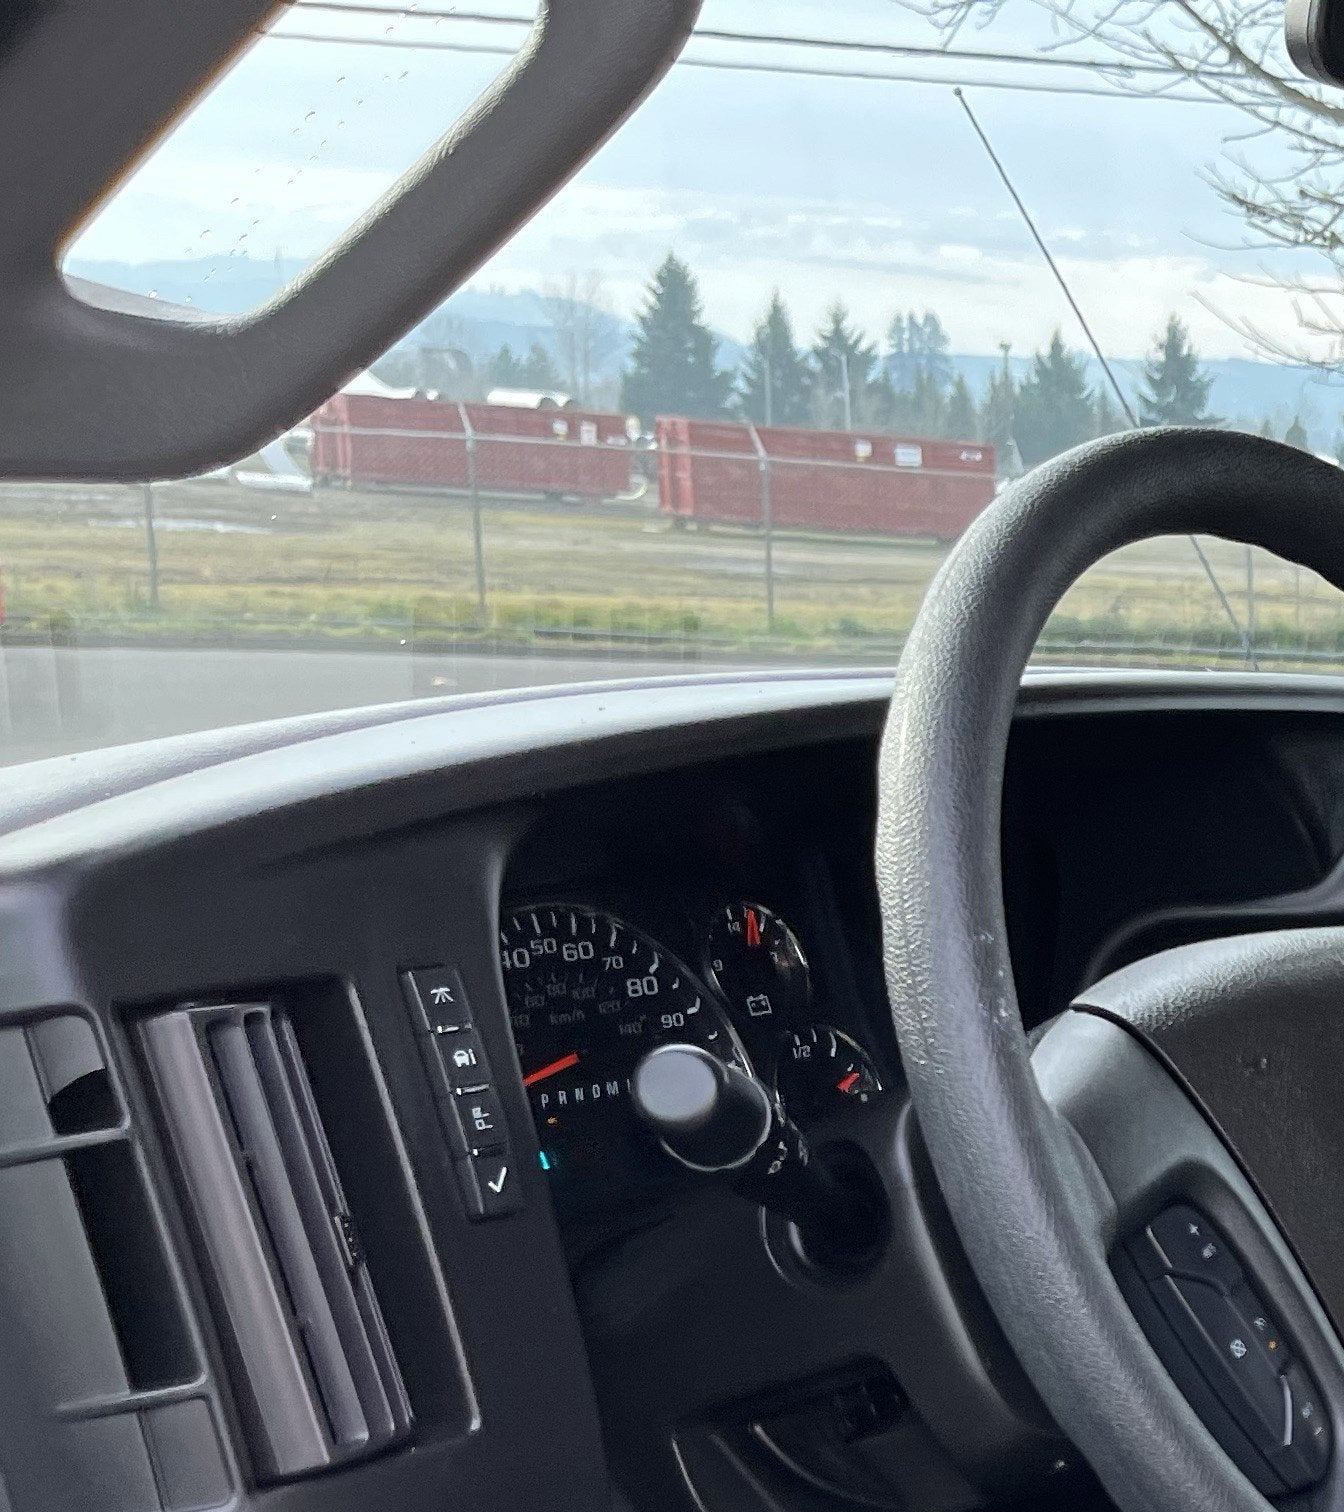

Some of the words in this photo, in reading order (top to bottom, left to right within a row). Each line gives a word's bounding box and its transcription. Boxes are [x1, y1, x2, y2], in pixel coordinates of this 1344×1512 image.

[529, 937, 557, 956] 50
[562, 940, 595, 962] 60
[501, 947, 530, 970] 40
[601, 954, 624, 971] 70
[626, 975, 659, 998] 80
[660, 1012, 685, 1029] 90
